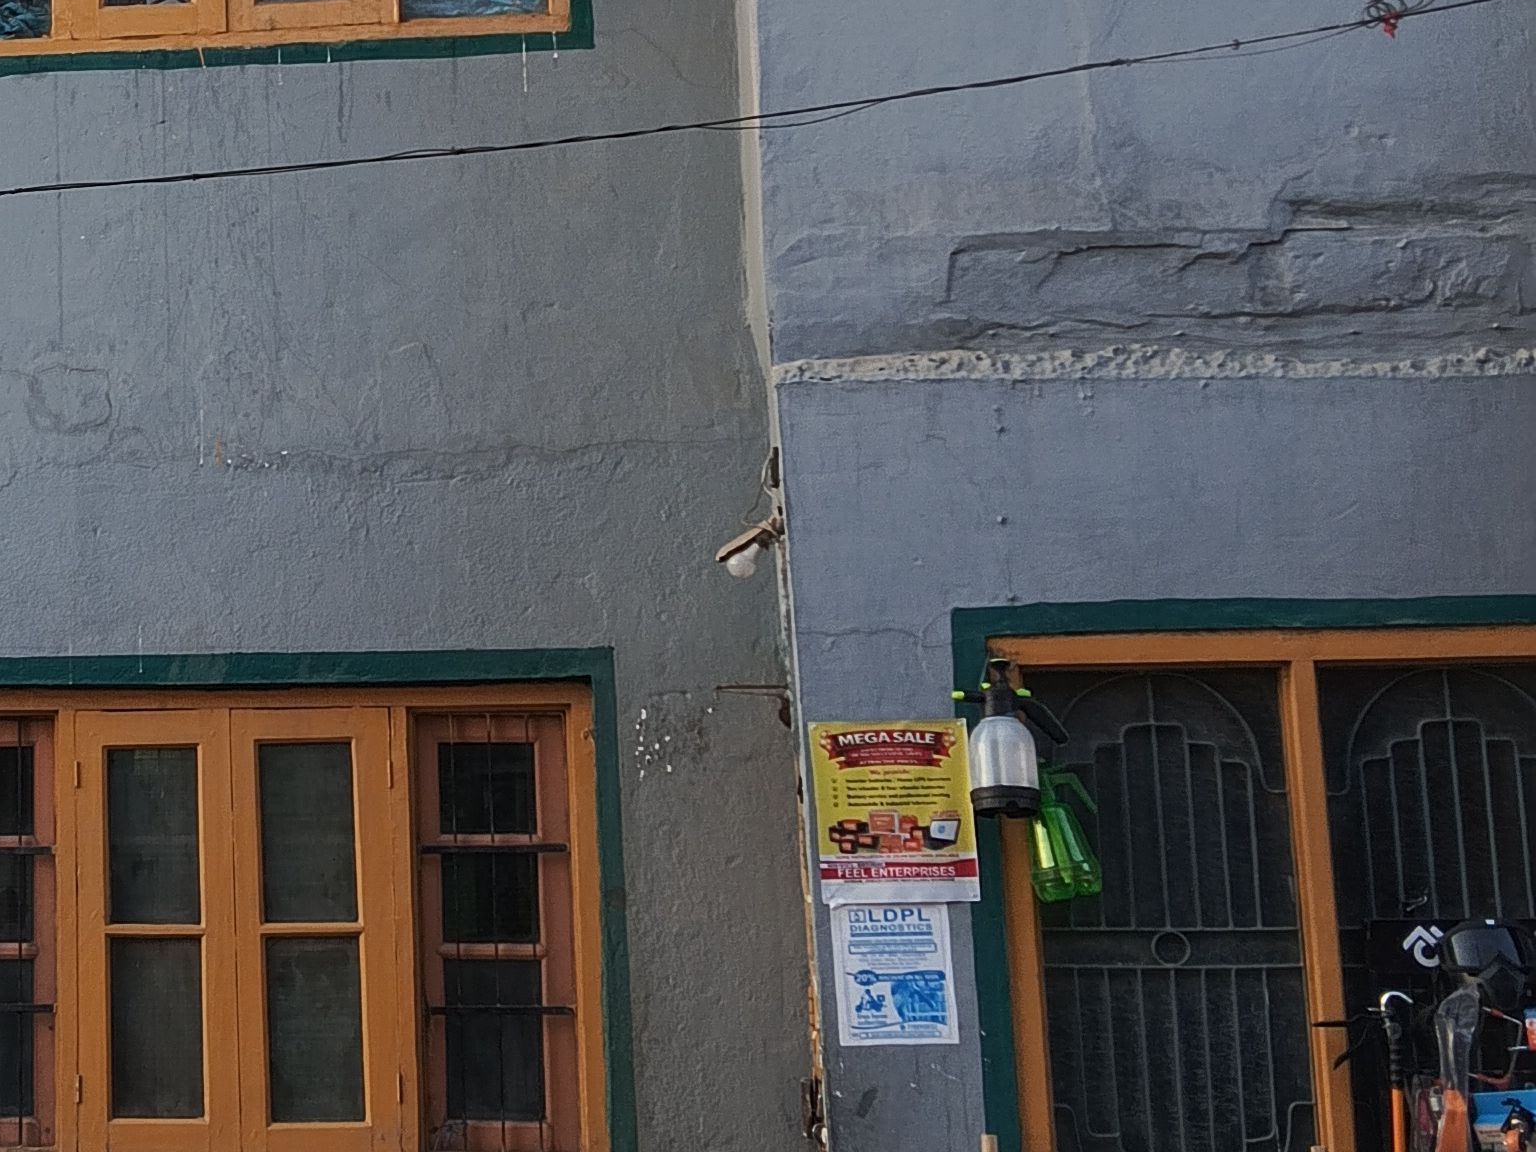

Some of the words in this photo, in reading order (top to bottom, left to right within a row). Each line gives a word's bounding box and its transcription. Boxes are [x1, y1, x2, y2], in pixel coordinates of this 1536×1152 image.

[838, 732, 890, 747] MEGA
[893, 731, 936, 744] SALE
[837, 868, 868, 878] FEEL
[871, 866, 956, 878] ENTERPRISES
[868, 908, 931, 923] LDPL
[850, 924, 933, 933] DIAGNOSTICS
